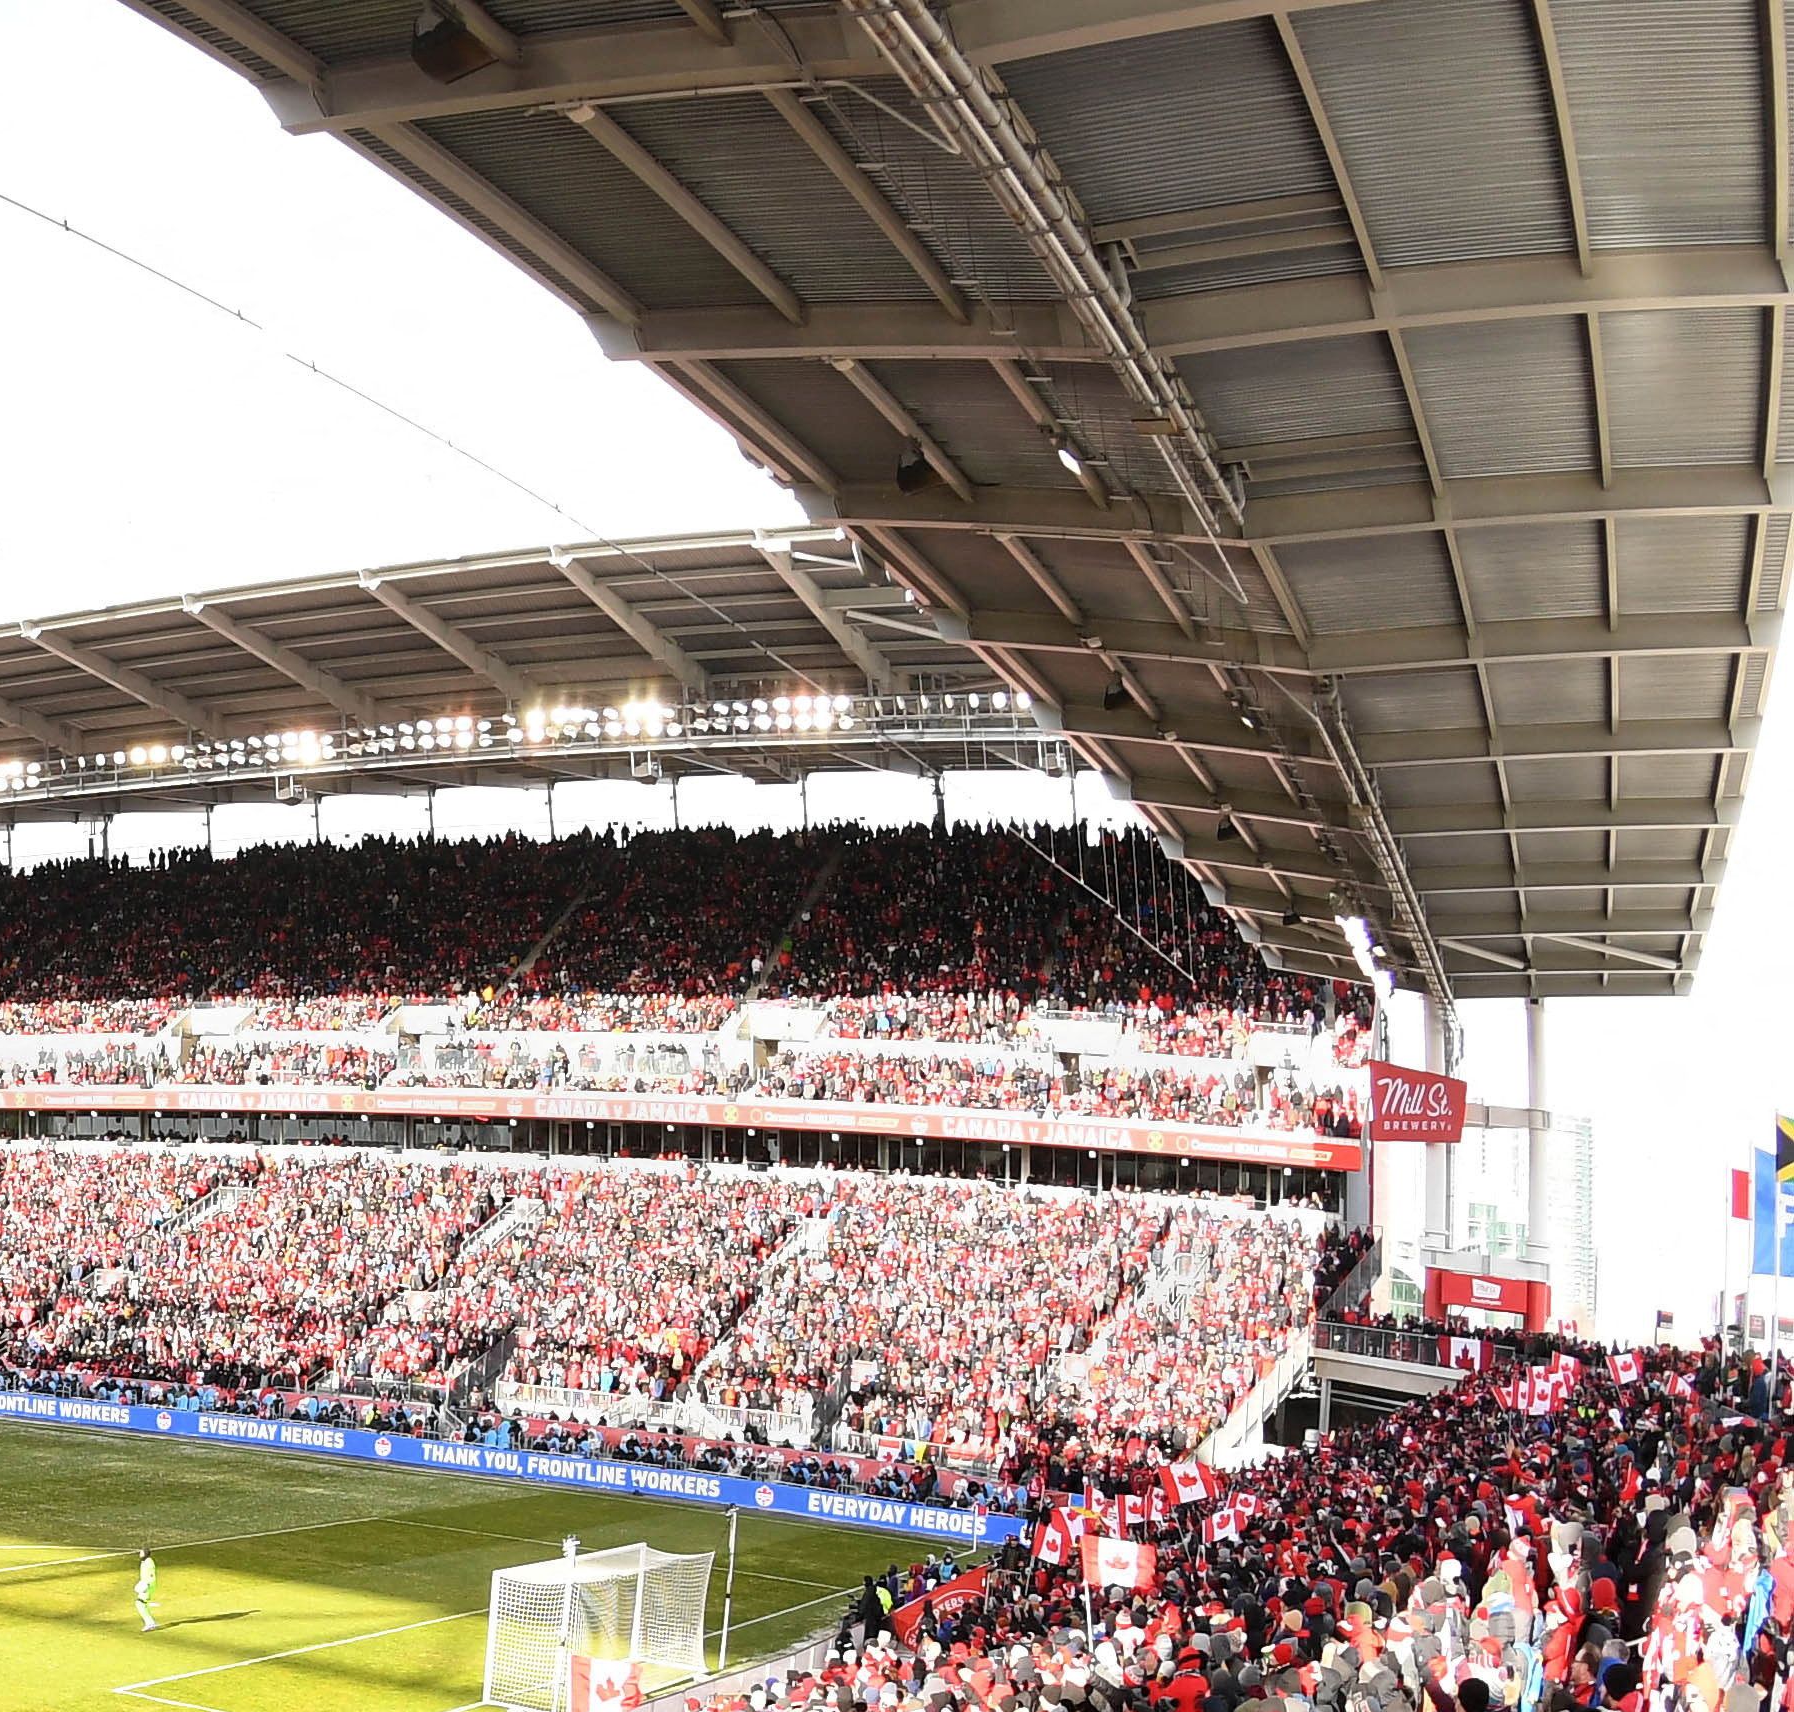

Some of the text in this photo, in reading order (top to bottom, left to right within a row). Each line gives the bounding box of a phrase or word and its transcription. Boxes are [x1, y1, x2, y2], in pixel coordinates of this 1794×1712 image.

[178, 1093, 242, 1108] CANADA
[258, 1094, 329, 1109] JAMAICA
[533, 1099, 609, 1118] CANADA
[625, 1102, 709, 1122] JAMAICA
[1376, 1077, 1453, 1117] Mill St.
[942, 1116, 1024, 1140] CANADA
[1042, 1125, 1132, 1149] JAMAICA
[1383, 1120, 1446, 1131] BREWERY
[59, 1400, 130, 1425] WORKERS
[198, 1416, 345, 1450] EVERYDAY HEROES
[421, 1443, 721, 1499] THANK YOU, FRONTLINE WORKERS
[807, 1491, 987, 1538] EVERYDAY HEROES
